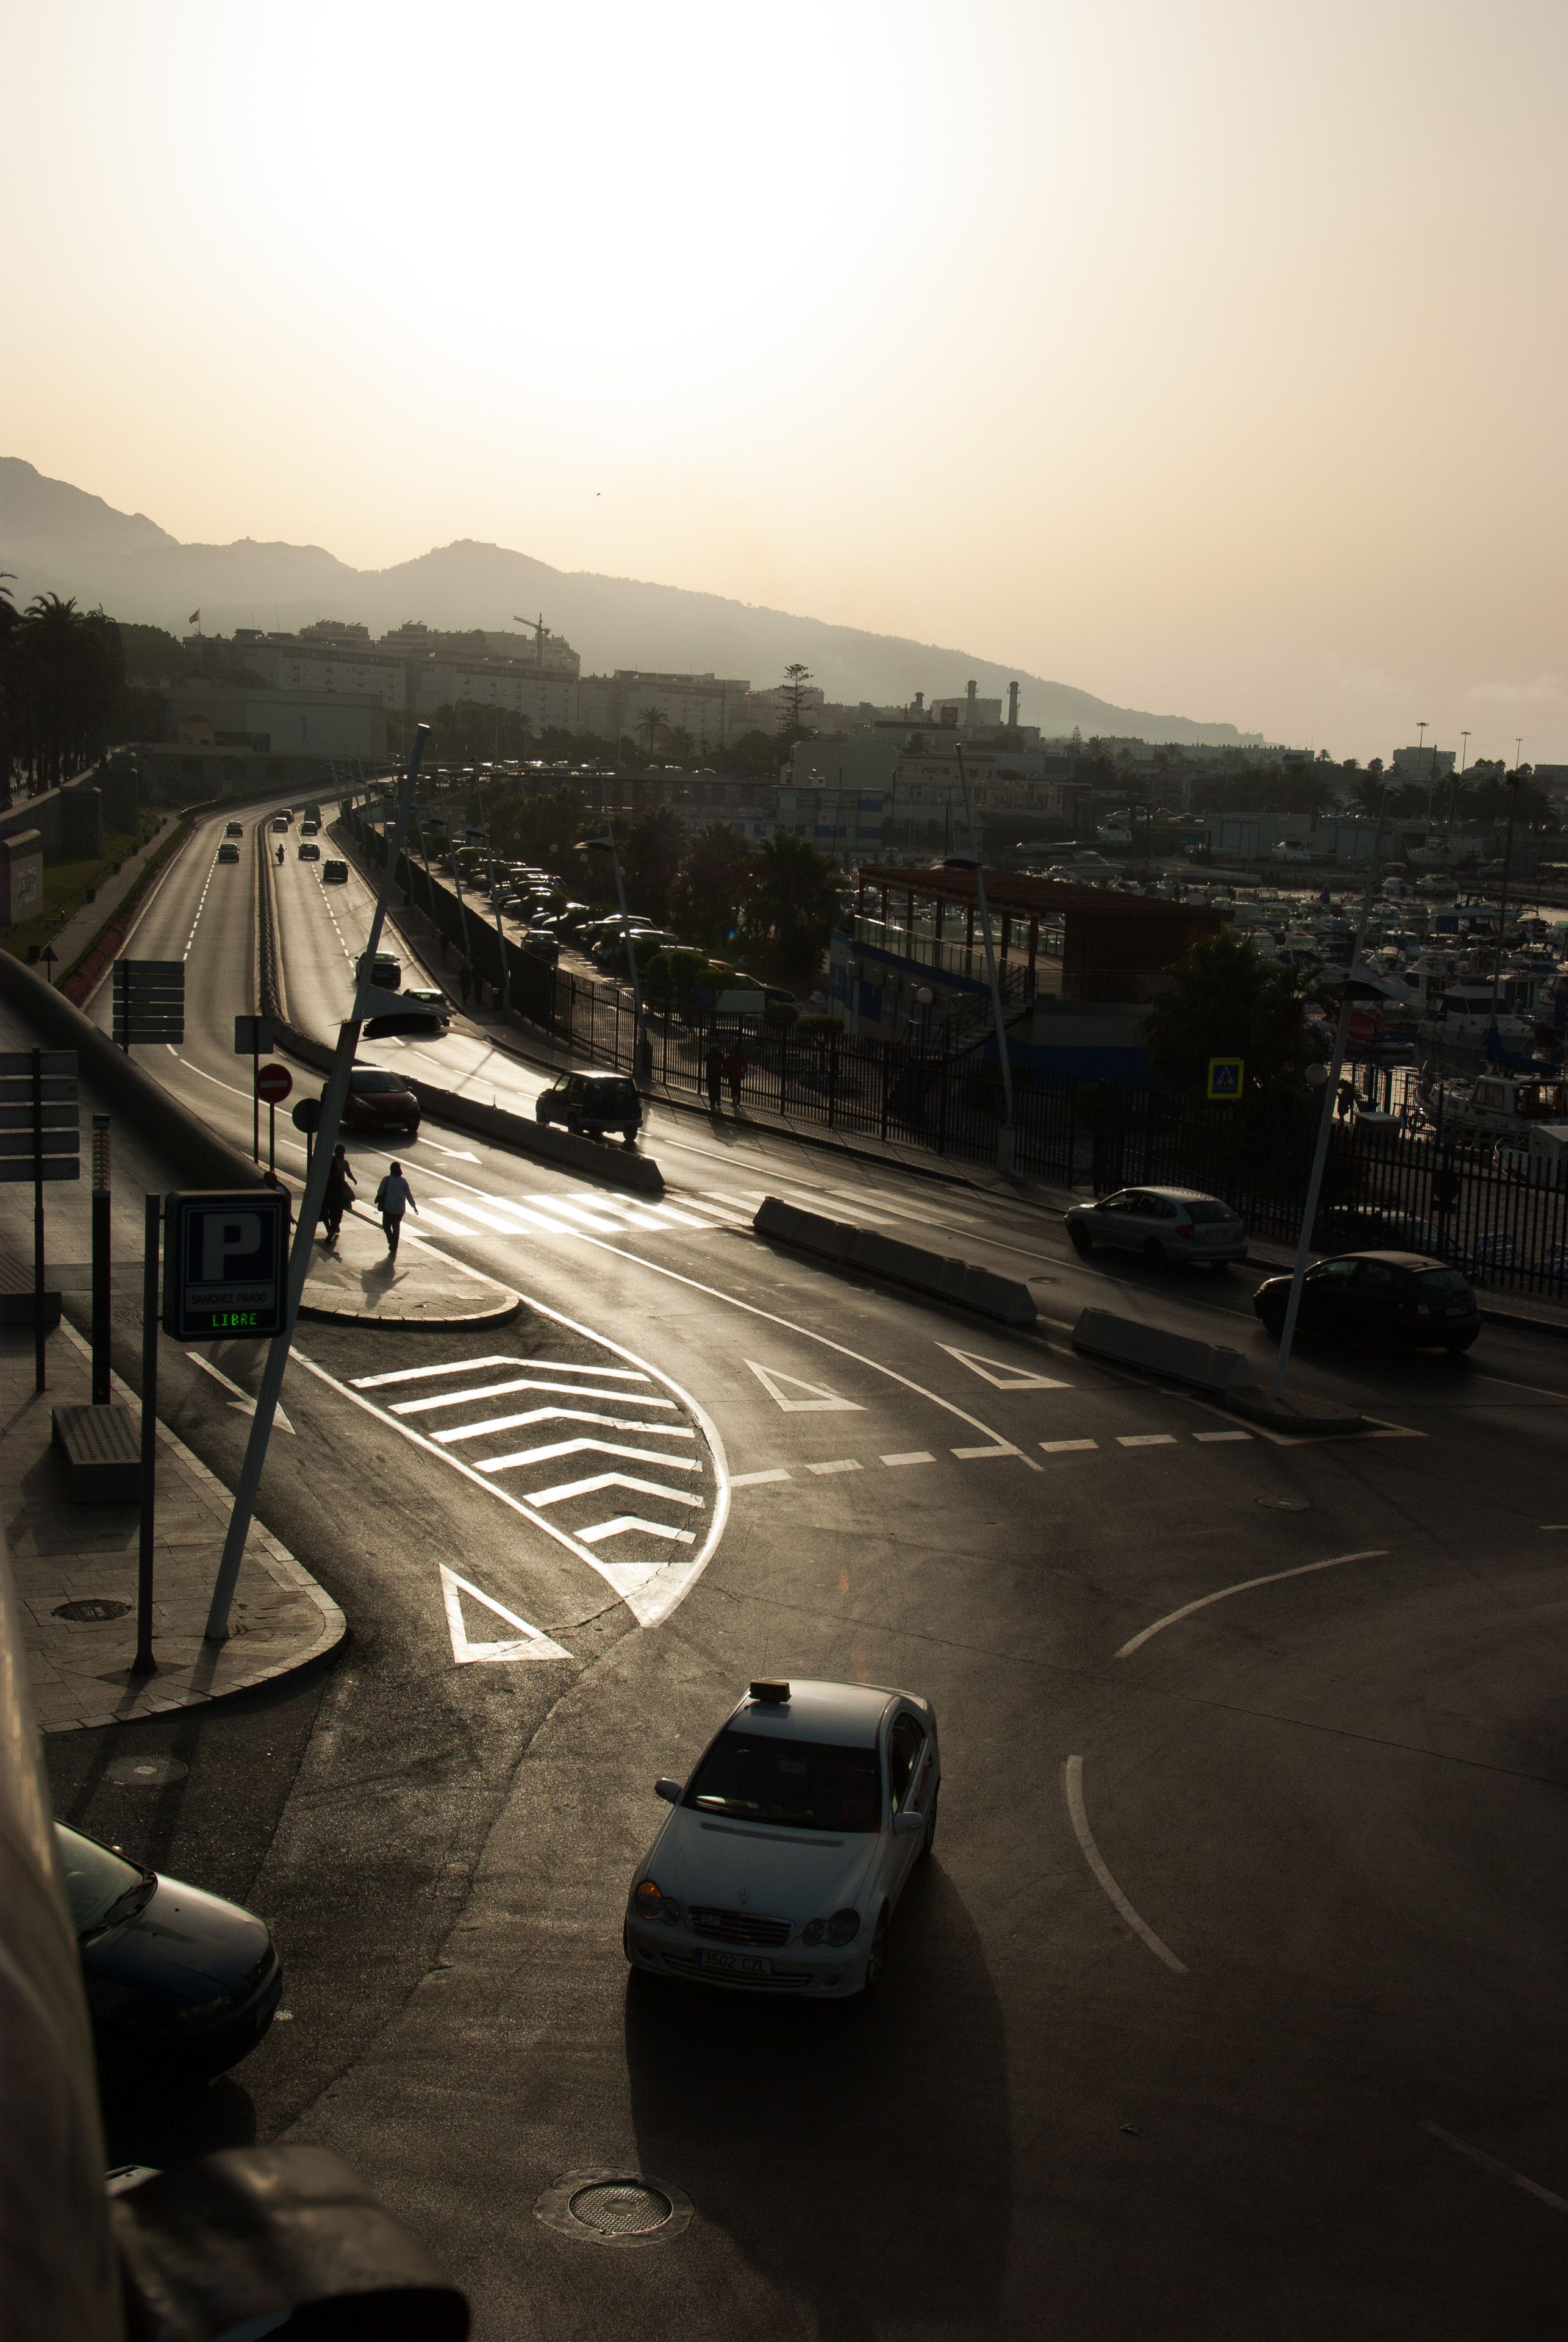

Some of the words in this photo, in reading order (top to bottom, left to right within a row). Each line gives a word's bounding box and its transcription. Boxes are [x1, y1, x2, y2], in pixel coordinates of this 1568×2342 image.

[202, 1212, 262, 1281] P
[191, 1293, 234, 1305] SANCHEZ
[236, 1292, 268, 1303] PRADO
[212, 1312, 258, 1327] LIBRE
[704, 1952, 736, 1968] 3502
[742, 1958, 766, 1972] CZL
